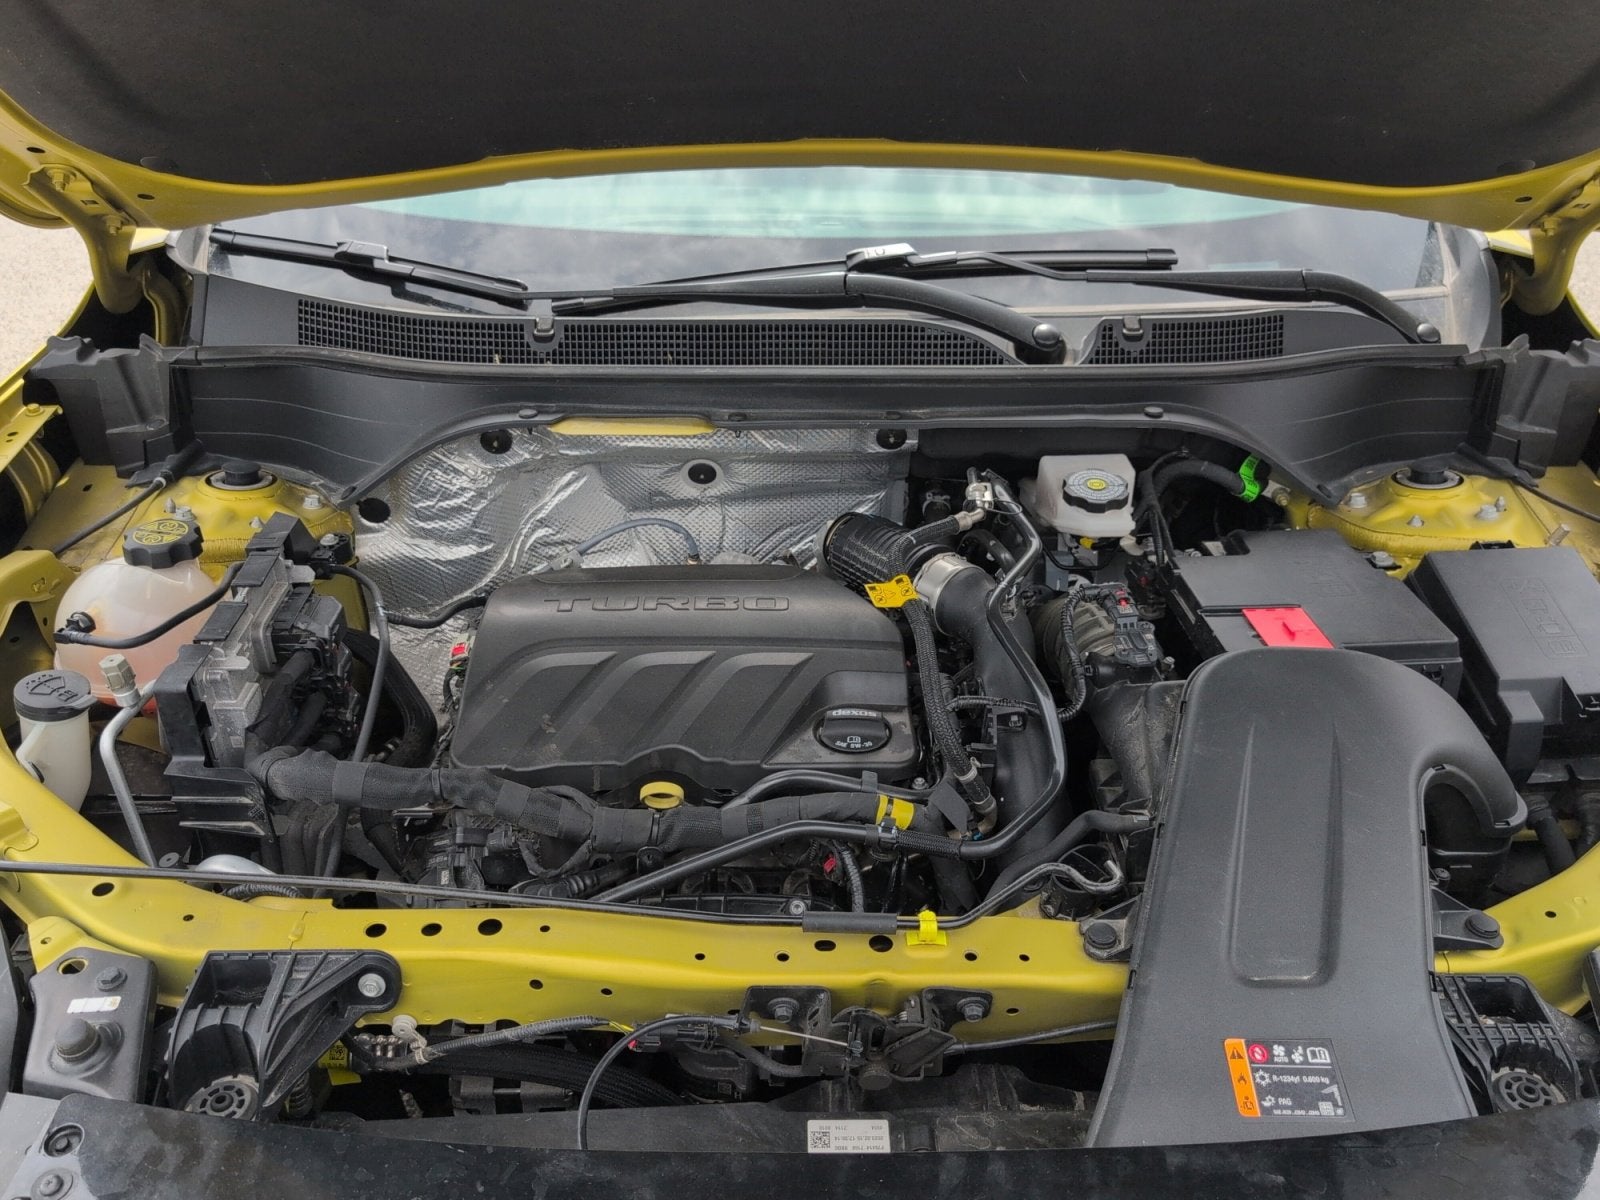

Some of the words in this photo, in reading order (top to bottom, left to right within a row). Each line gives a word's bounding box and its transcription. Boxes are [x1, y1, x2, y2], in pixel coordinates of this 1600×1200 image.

[544, 596, 789, 612] TURBO
[1272, 1074, 1301, 1084] R-1234yf
[1320, 1076, 1330, 1084] kg
[1278, 1097, 1292, 1106] PAG
